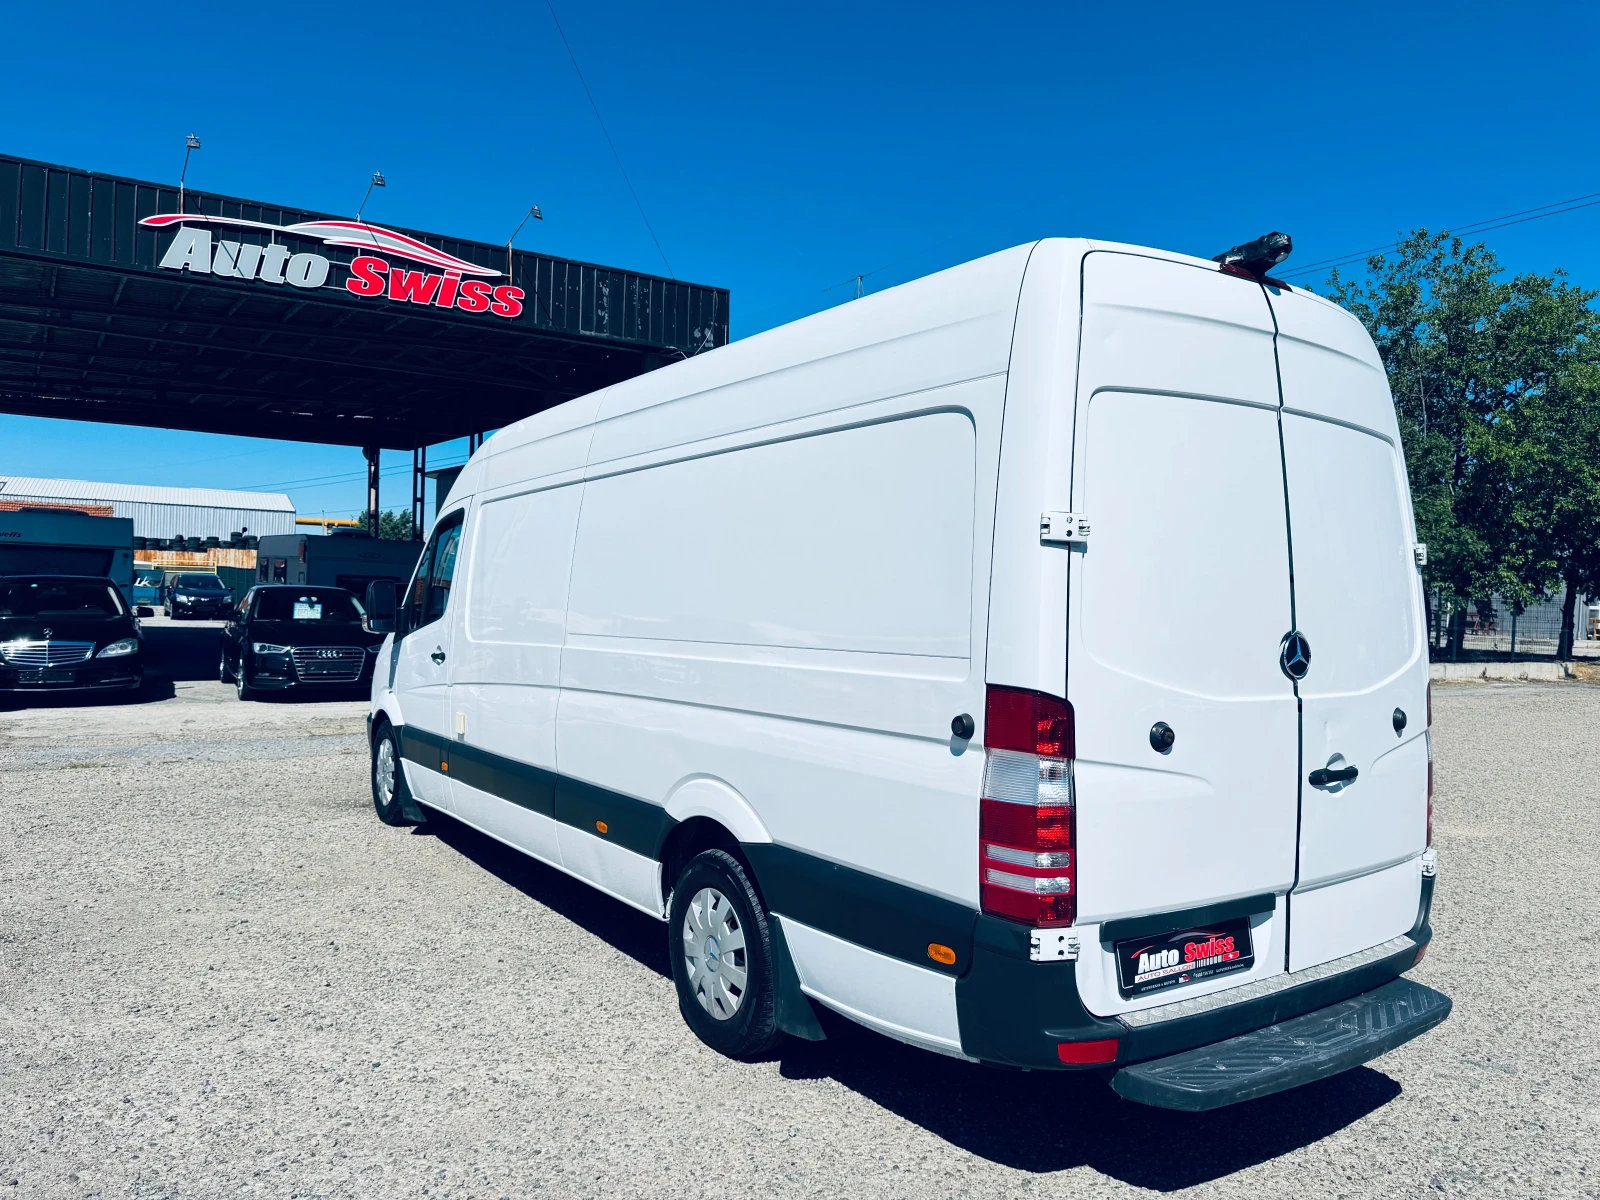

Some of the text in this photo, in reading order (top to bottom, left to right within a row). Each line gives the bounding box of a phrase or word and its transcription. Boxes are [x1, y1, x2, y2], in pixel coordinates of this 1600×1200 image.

[159, 226, 526, 318] Auto Swiss
[1137, 936, 1235, 975] Auto Swiss
[1138, 971, 1161, 982] AUTO
[1162, 963, 1194, 976] SALLON
